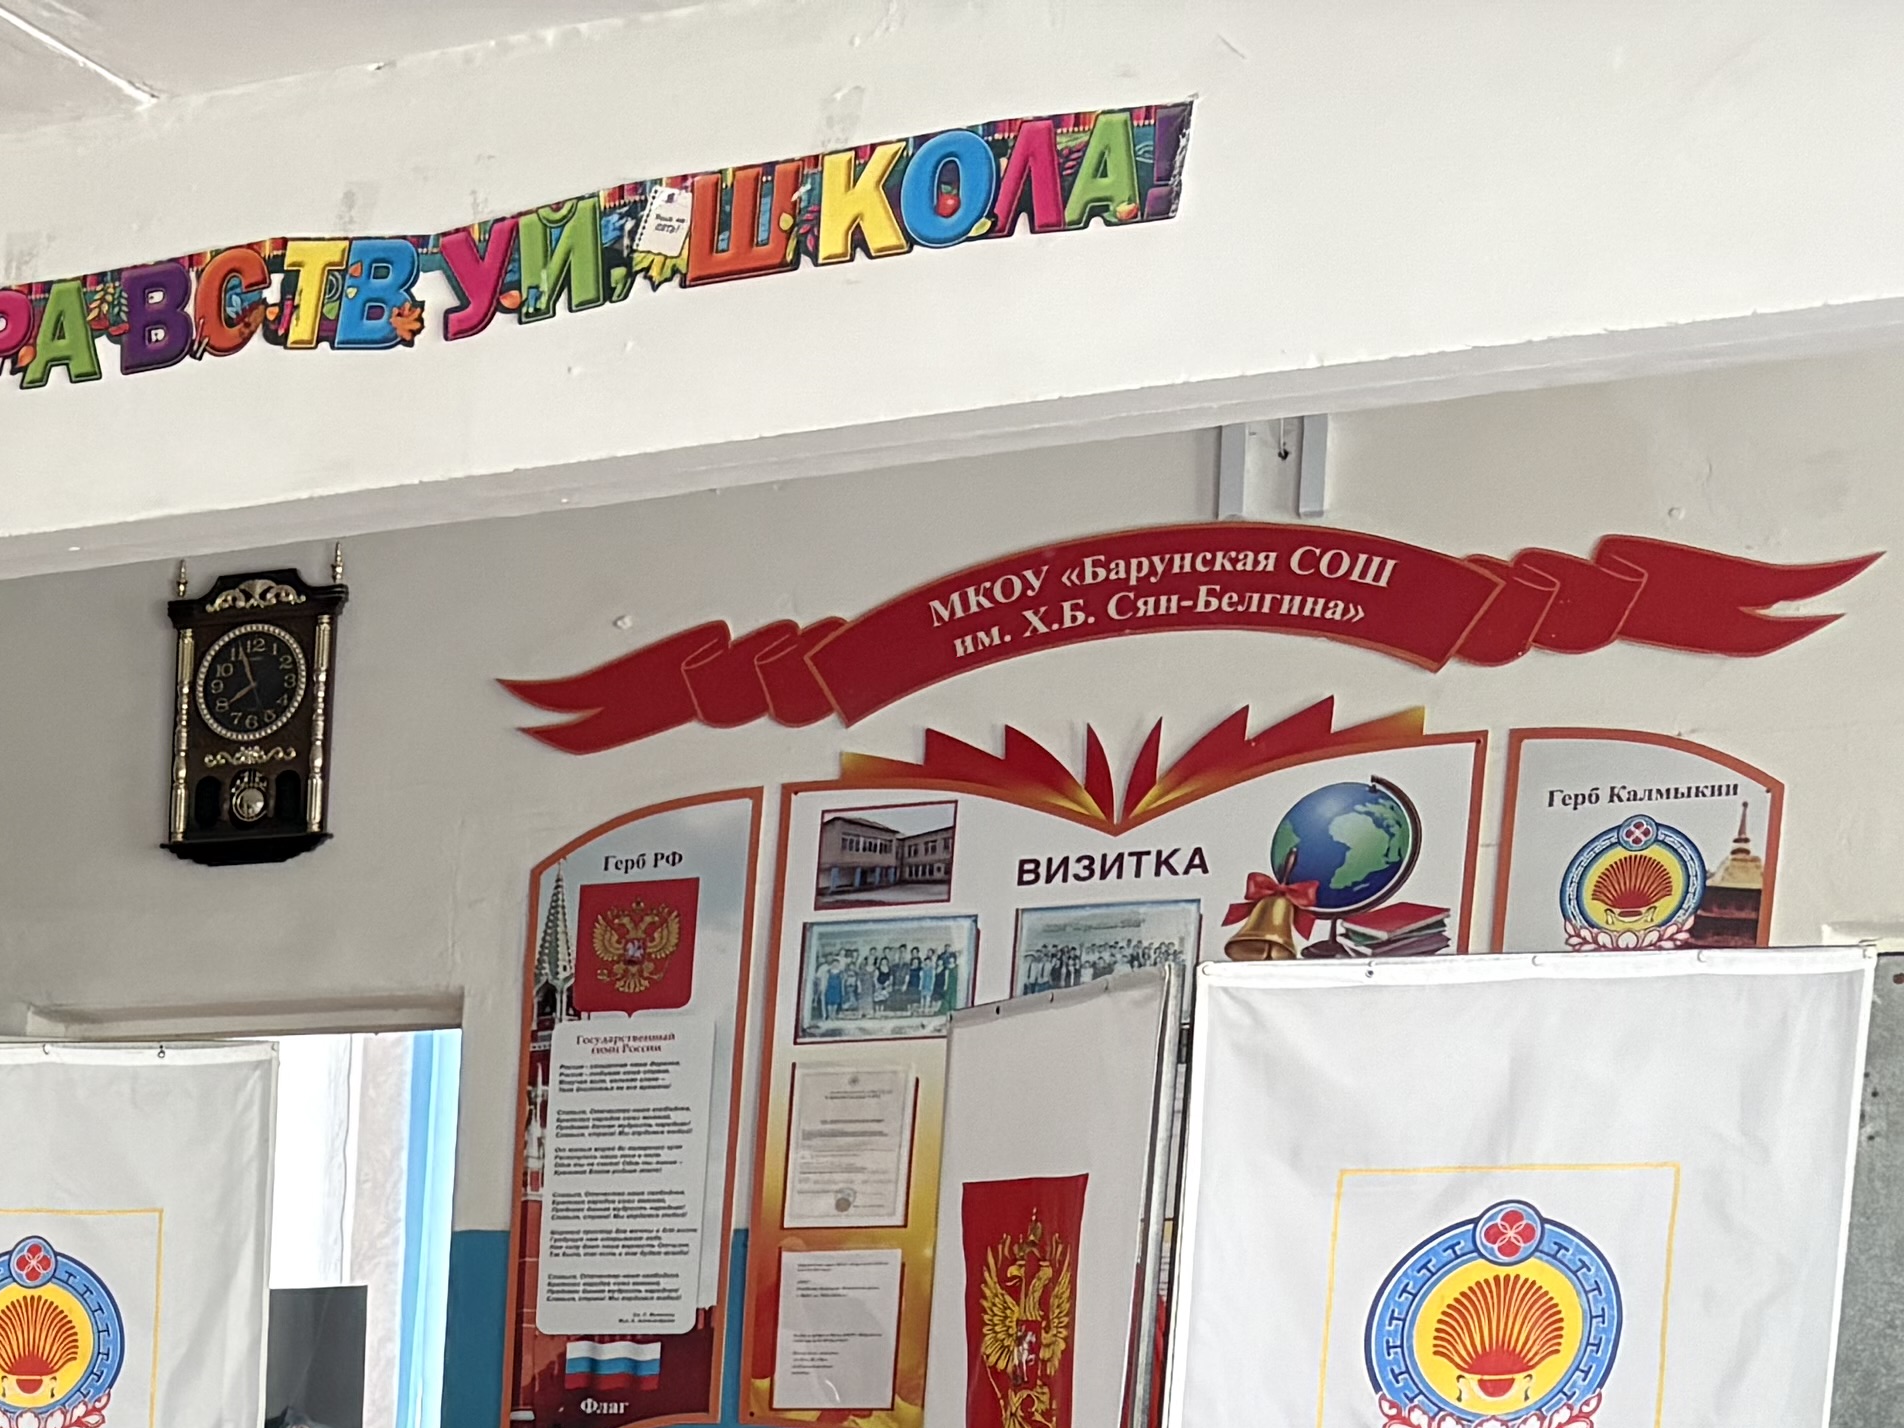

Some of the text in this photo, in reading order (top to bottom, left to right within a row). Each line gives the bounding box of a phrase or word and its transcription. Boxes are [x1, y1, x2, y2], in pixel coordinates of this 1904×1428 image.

[687, 103, 1186, 286] ШКОЛА!
[928, 545, 1399, 627] МКОУ «Барунская СОШ
[953, 584, 1366, 659] им. Х.Б. Сян-Белгина»
[247, 638, 266, 653] 12
[216, 663, 233, 678] 10
[211, 679, 224, 694] 9
[284, 673, 296, 688] 3
[215, 697, 230, 712] 8
[231, 712, 243, 725] 7
[245, 714, 259, 729] 6
[1547, 782, 1739, 810] Герб Калмыкии
[603, 848, 684, 873] Герб РФ
[1015, 840, 1211, 887] ВИЗИТКА
[581, 1397, 629, 1415] Флаг
